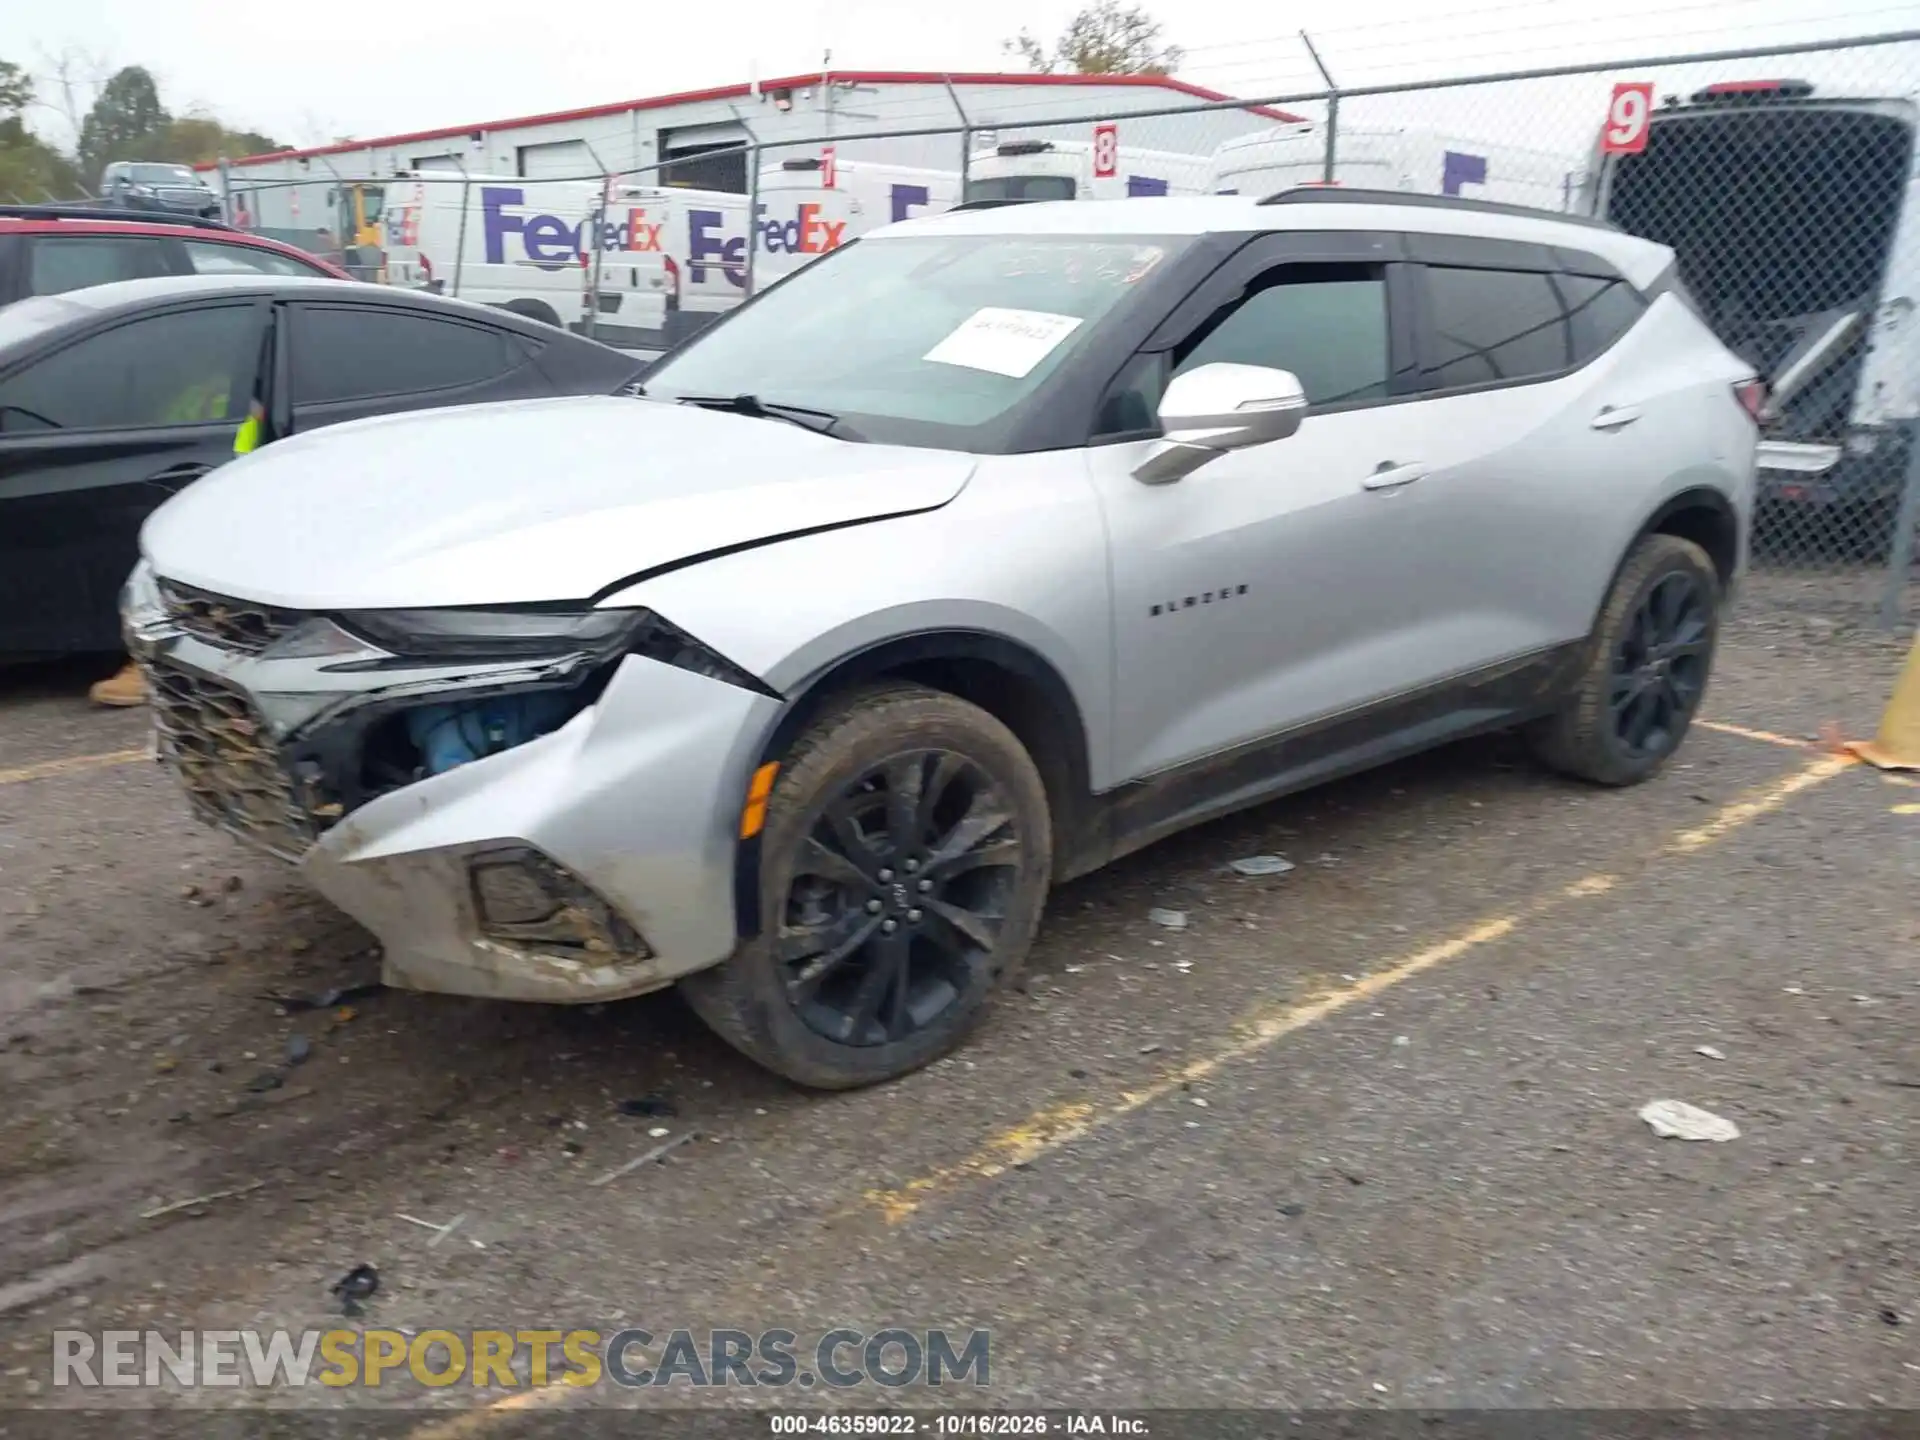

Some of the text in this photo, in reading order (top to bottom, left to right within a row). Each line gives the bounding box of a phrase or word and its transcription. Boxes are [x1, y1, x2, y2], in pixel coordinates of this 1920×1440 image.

[1608, 90, 1648, 145] 9
[1095, 130, 1116, 171] 8
[481, 187, 581, 271] Fe
